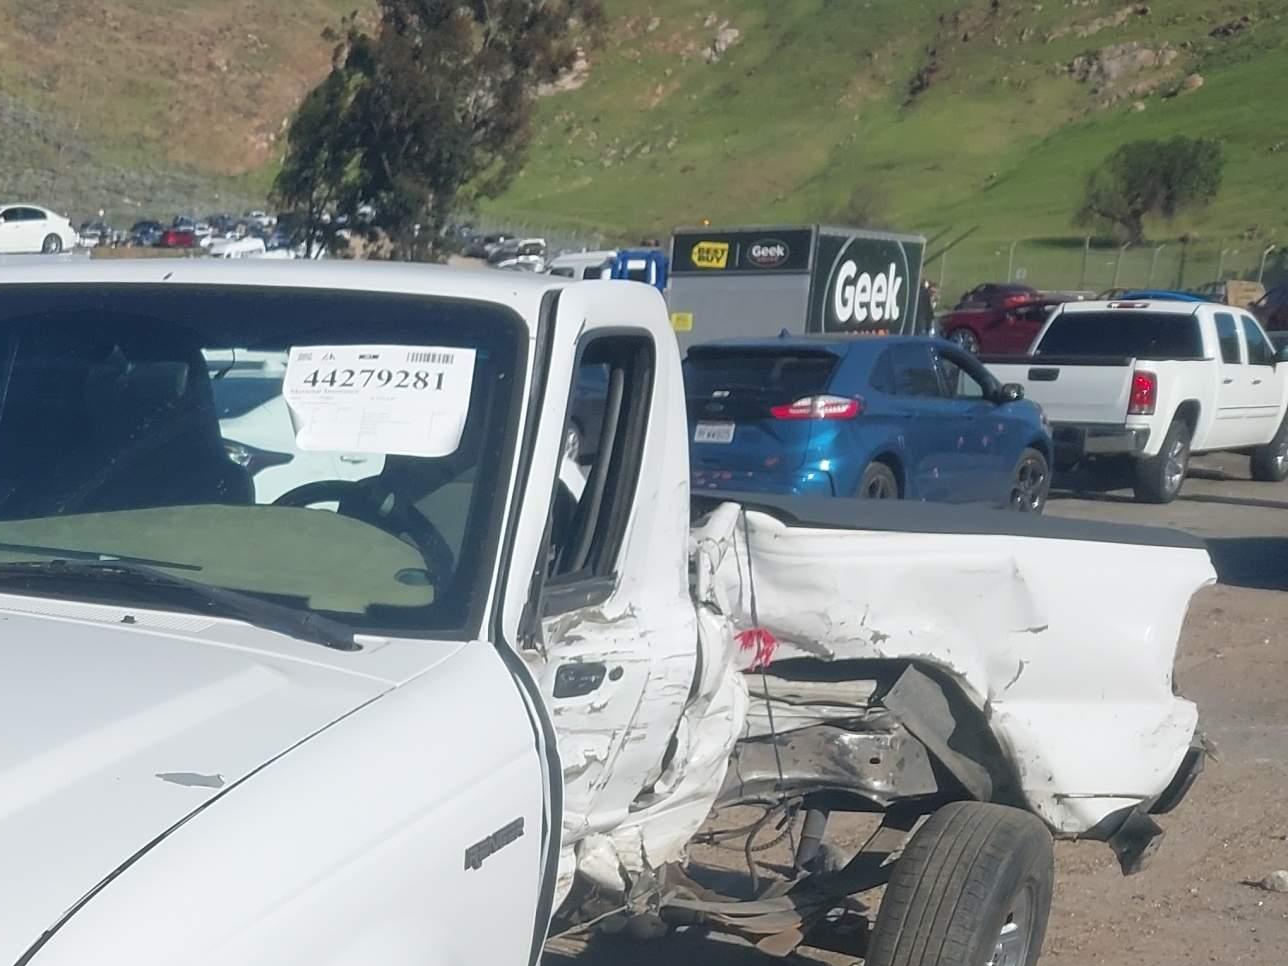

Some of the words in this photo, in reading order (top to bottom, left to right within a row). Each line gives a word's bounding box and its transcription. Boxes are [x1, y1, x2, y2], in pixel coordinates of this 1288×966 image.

[696, 247, 725, 257] BEST
[752, 244, 785, 257] Geek
[696, 256, 721, 264] BUY
[835, 260, 902, 322] Geek
[303, 369, 446, 391] 44279281
